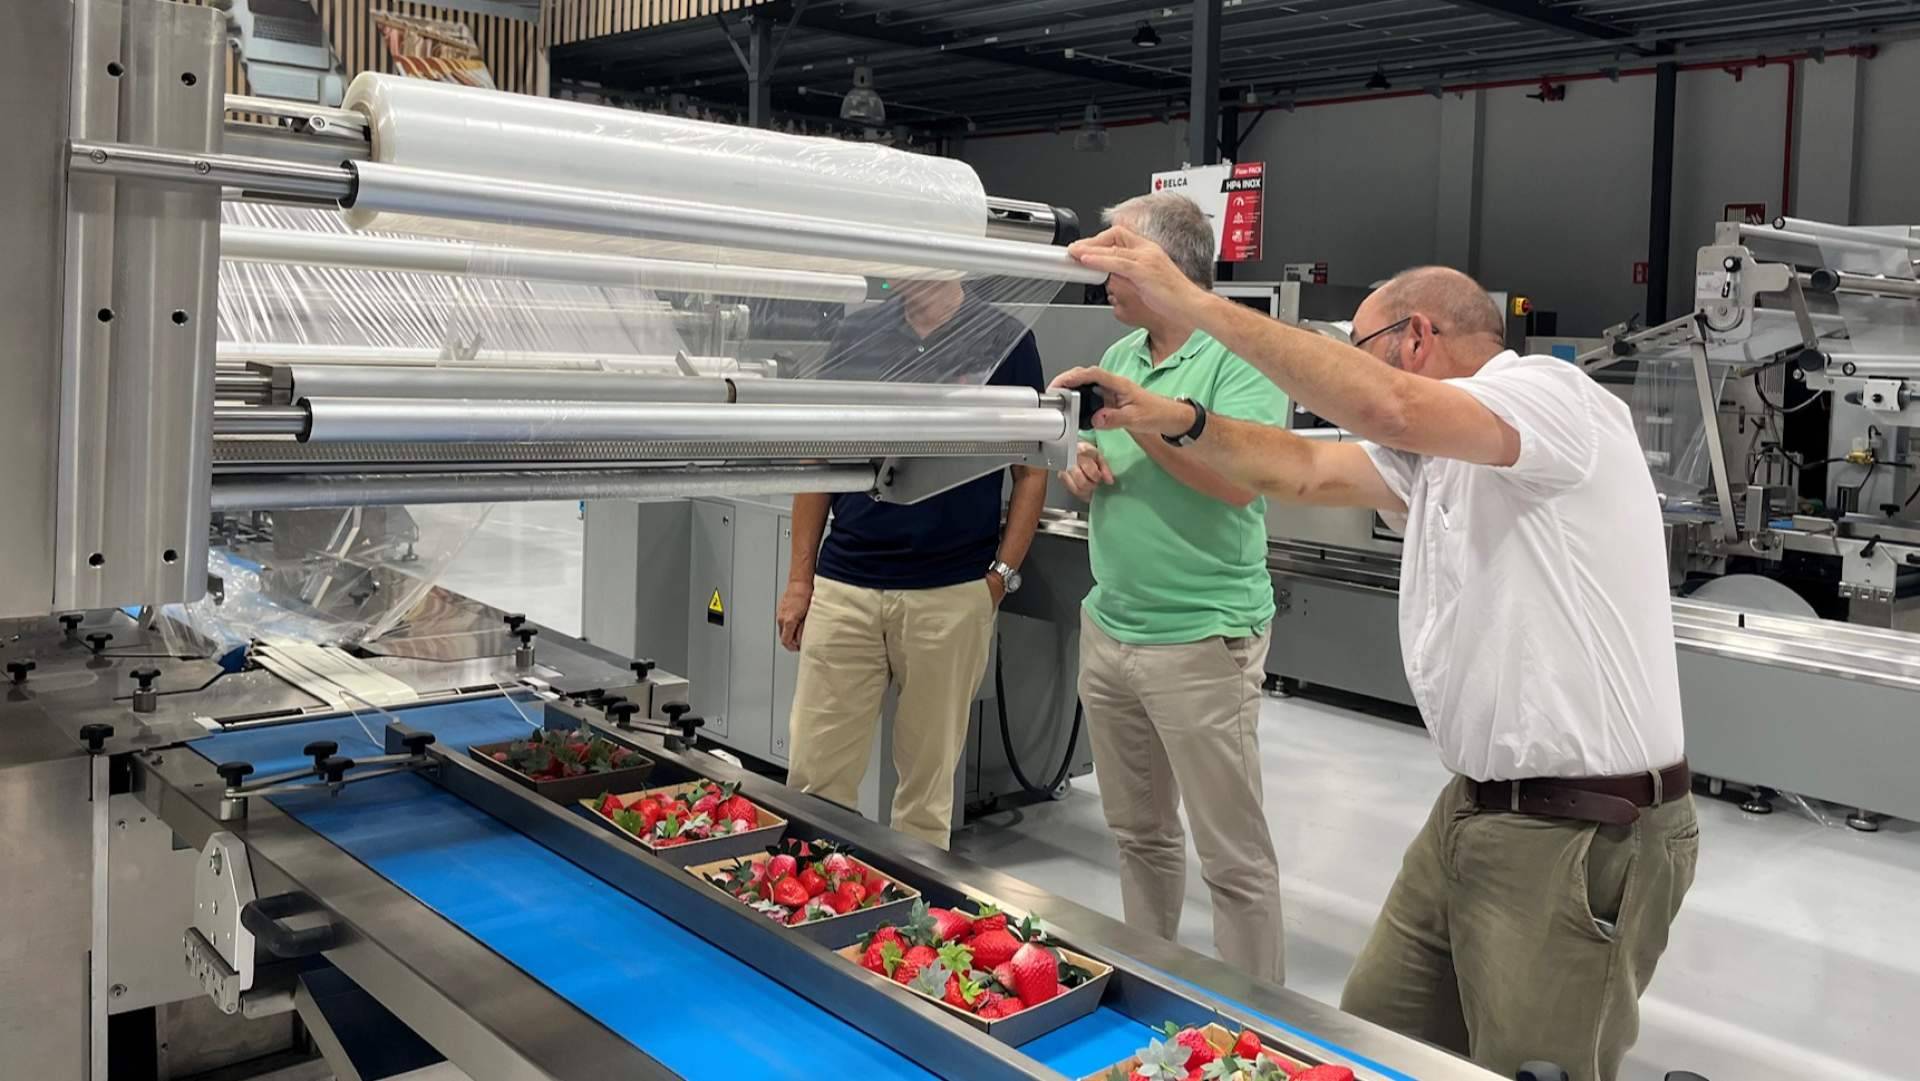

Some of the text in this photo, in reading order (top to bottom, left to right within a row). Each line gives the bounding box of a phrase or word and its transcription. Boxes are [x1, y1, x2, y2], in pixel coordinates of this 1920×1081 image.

[1163, 177, 1188, 188] BELCA
[1226, 178, 1261, 190] HP4 INOX
